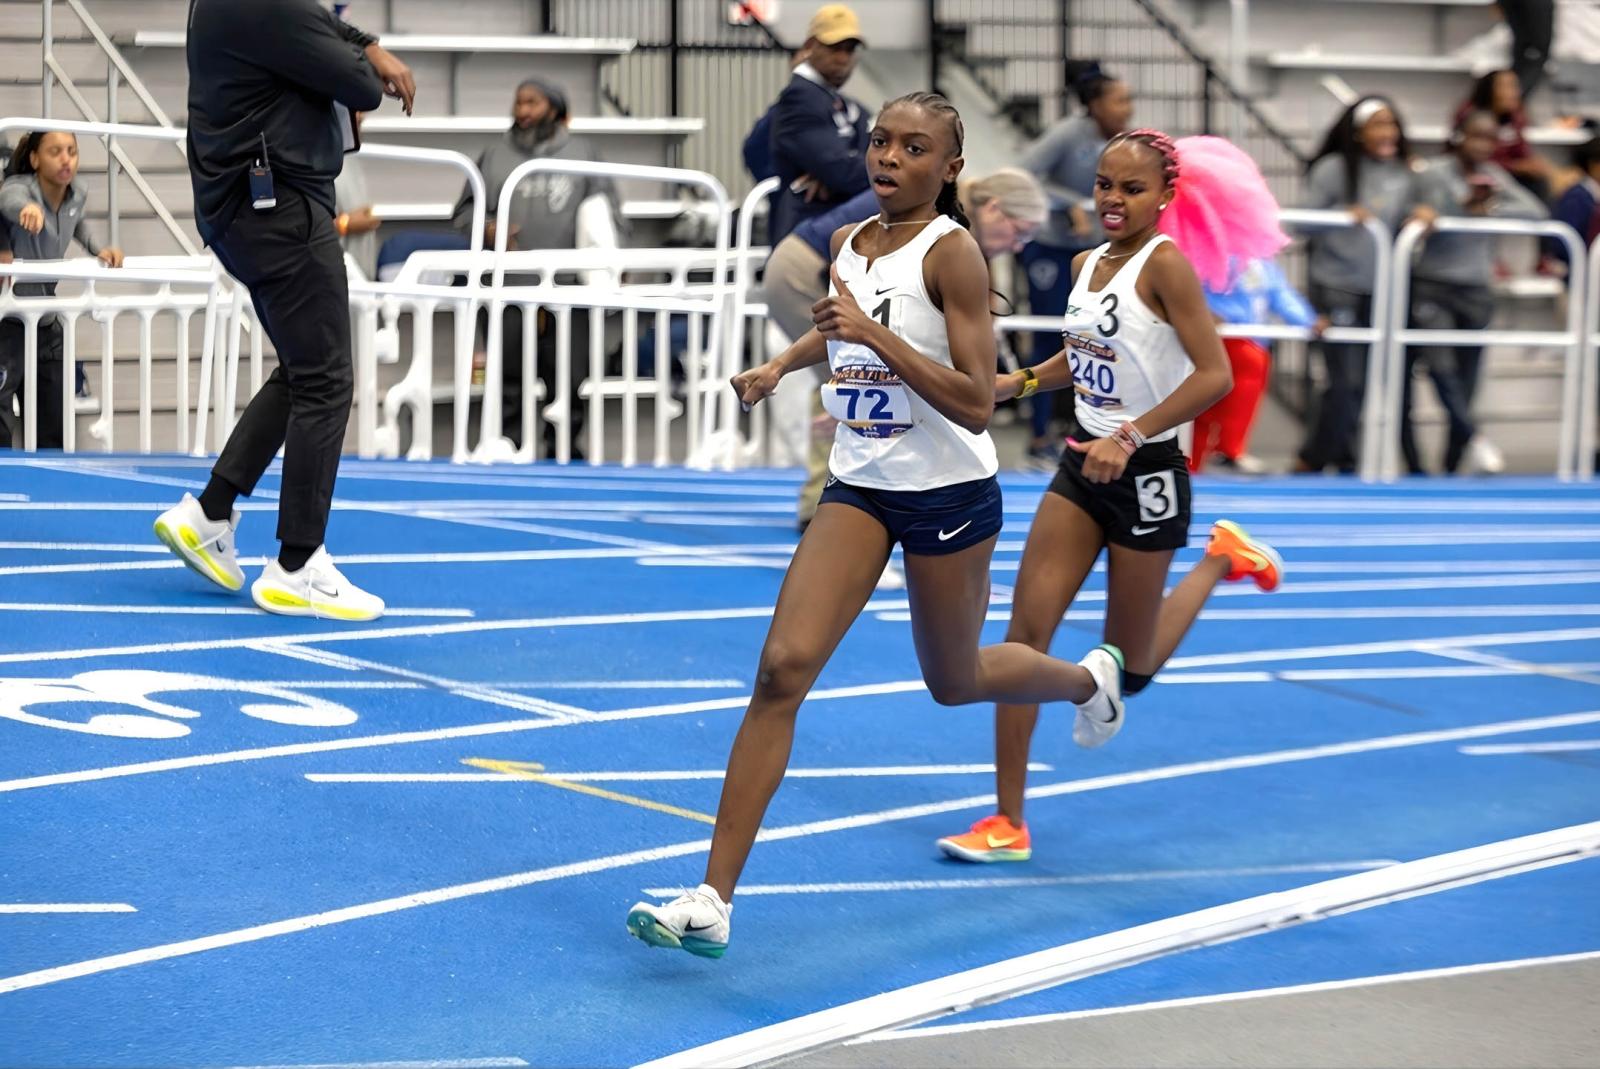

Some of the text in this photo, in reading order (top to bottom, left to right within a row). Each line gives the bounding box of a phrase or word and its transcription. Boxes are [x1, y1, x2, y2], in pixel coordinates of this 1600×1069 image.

[872, 298, 891, 330] 1
[1097, 293, 1119, 338] 3
[1071, 353, 1114, 394] 240
[836, 388, 894, 420] 72
[1142, 476, 1169, 518] 3
